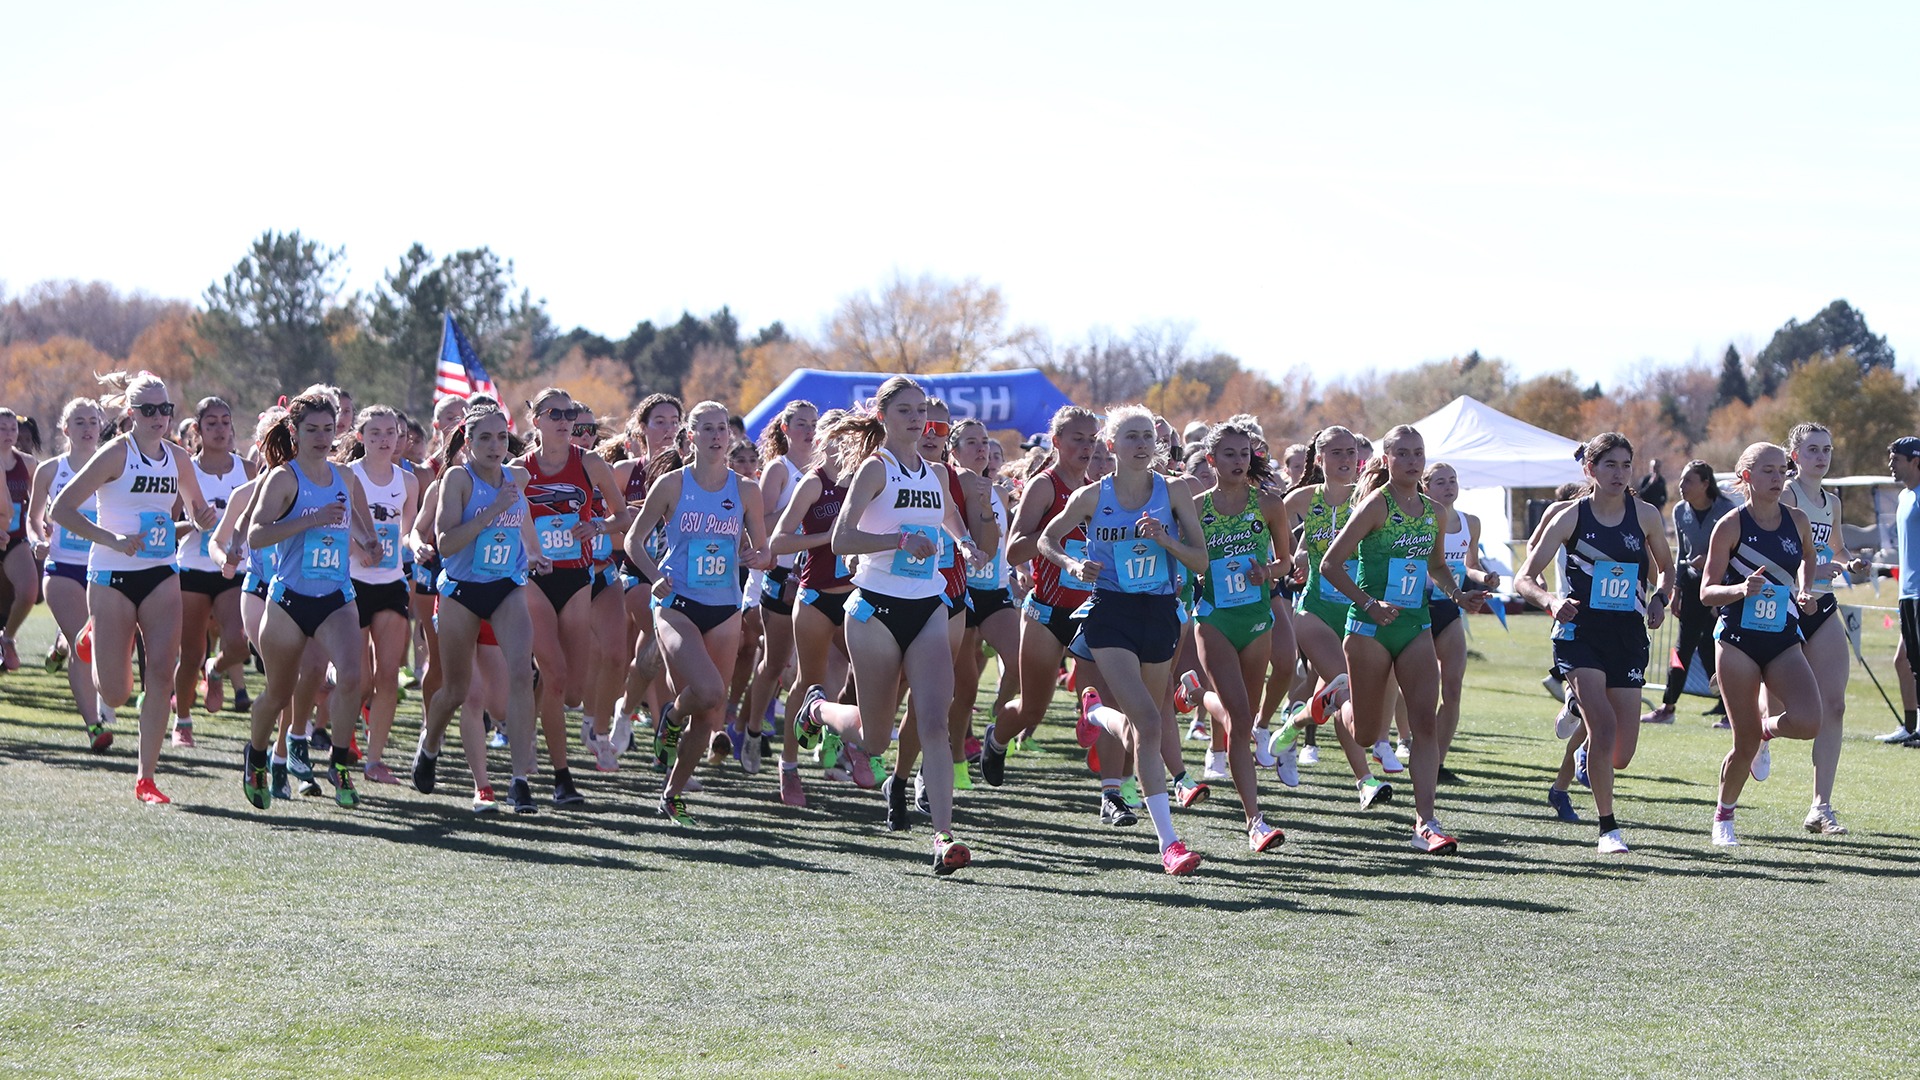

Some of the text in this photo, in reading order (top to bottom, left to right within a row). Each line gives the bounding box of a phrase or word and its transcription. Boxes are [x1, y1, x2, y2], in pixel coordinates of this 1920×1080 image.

[853, 385, 1011, 420] FSH
[130, 475, 178, 494] BHSU
[894, 489, 941, 509] BHSU
[496, 508, 524, 528] Puebl
[680, 512, 740, 536] CSU Pueblo
[149, 527, 167, 546] 32
[541, 529, 574, 549] 389
[1096, 526, 1127, 541] FORT
[1207, 529, 1252, 550] Adams
[1391, 533, 1433, 549] Adams
[312, 548, 340, 568] 134
[484, 544, 511, 565] 137
[1223, 541, 1257, 558] State
[1445, 551, 1466, 559] TYLE
[696, 555, 726, 576] 136
[1125, 555, 1157, 580] 177
[1225, 572, 1246, 594] 18
[1400, 576, 1418, 595] 17
[1600, 577, 1630, 598] 102
[1754, 599, 1777, 620] 98
[1352, 619, 1363, 632] 17
